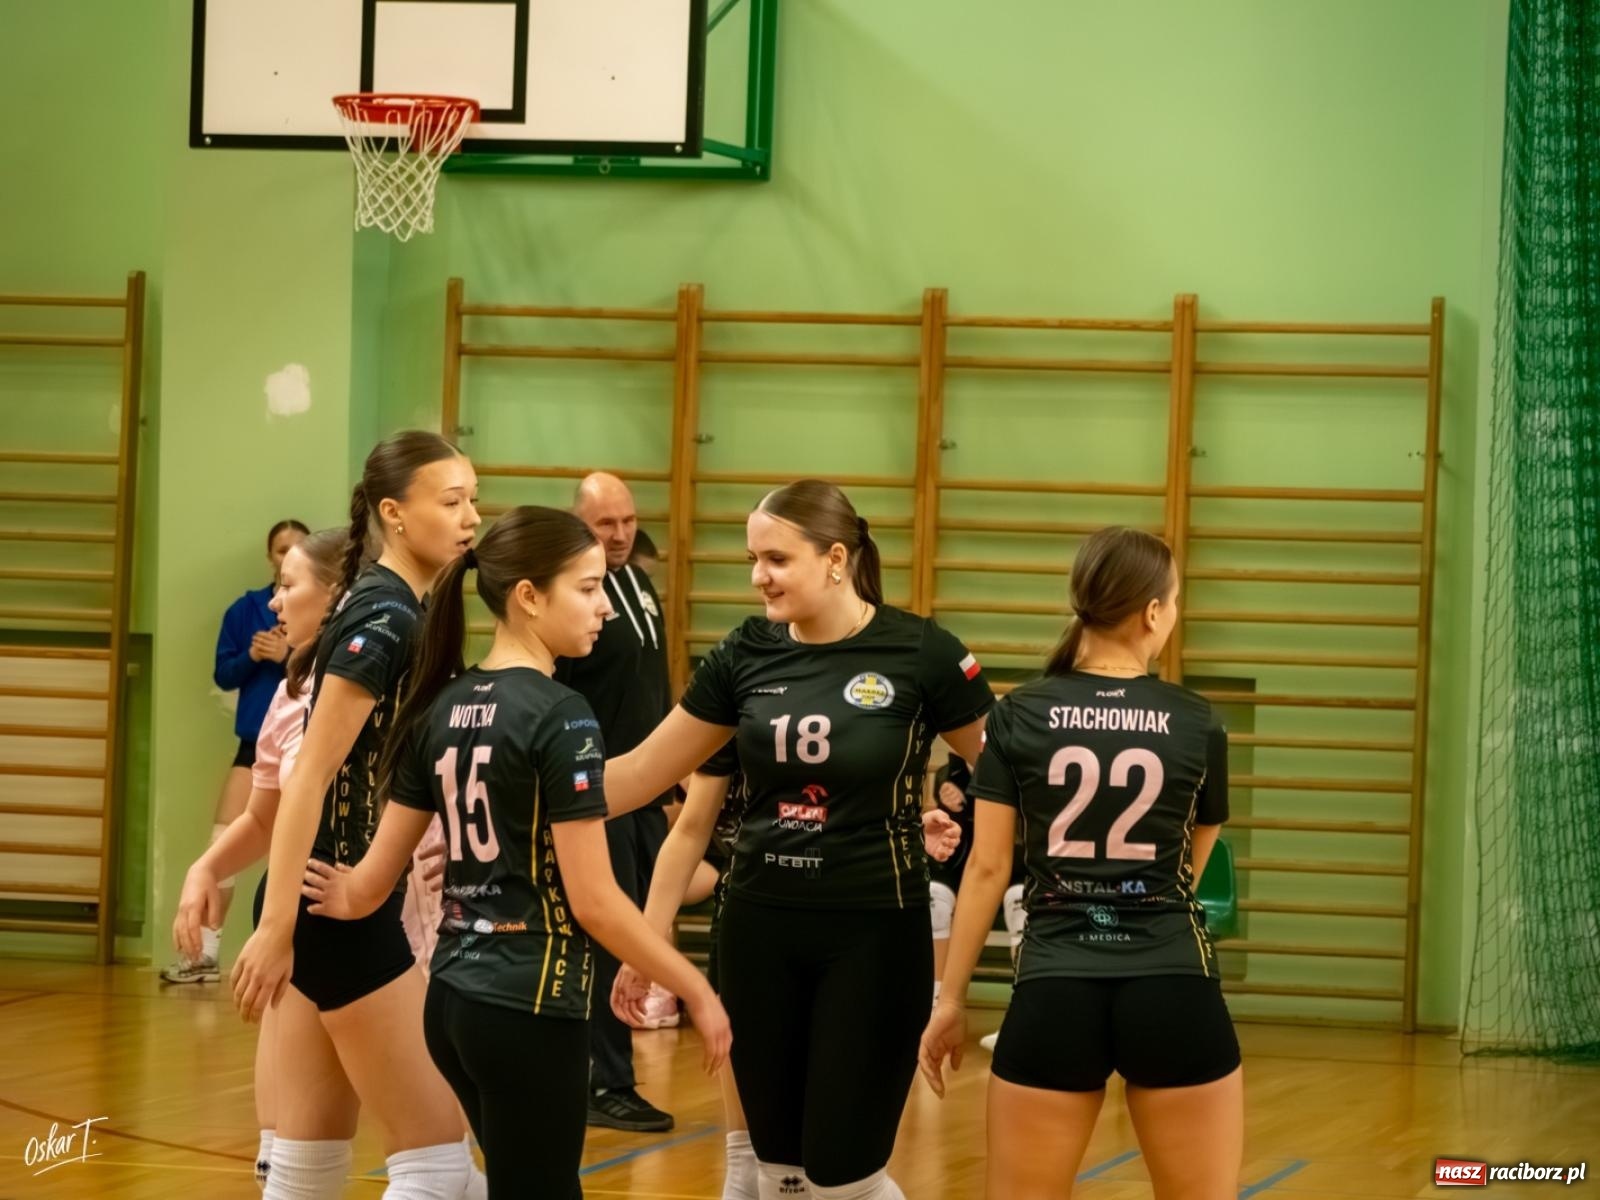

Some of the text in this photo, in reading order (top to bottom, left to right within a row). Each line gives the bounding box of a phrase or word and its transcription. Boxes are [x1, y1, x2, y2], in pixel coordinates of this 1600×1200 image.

[770, 714, 831, 765] 18
[1048, 706, 1171, 735] STACHOWIAK
[435, 745, 500, 864] 15
[1047, 745, 1165, 861] 22
